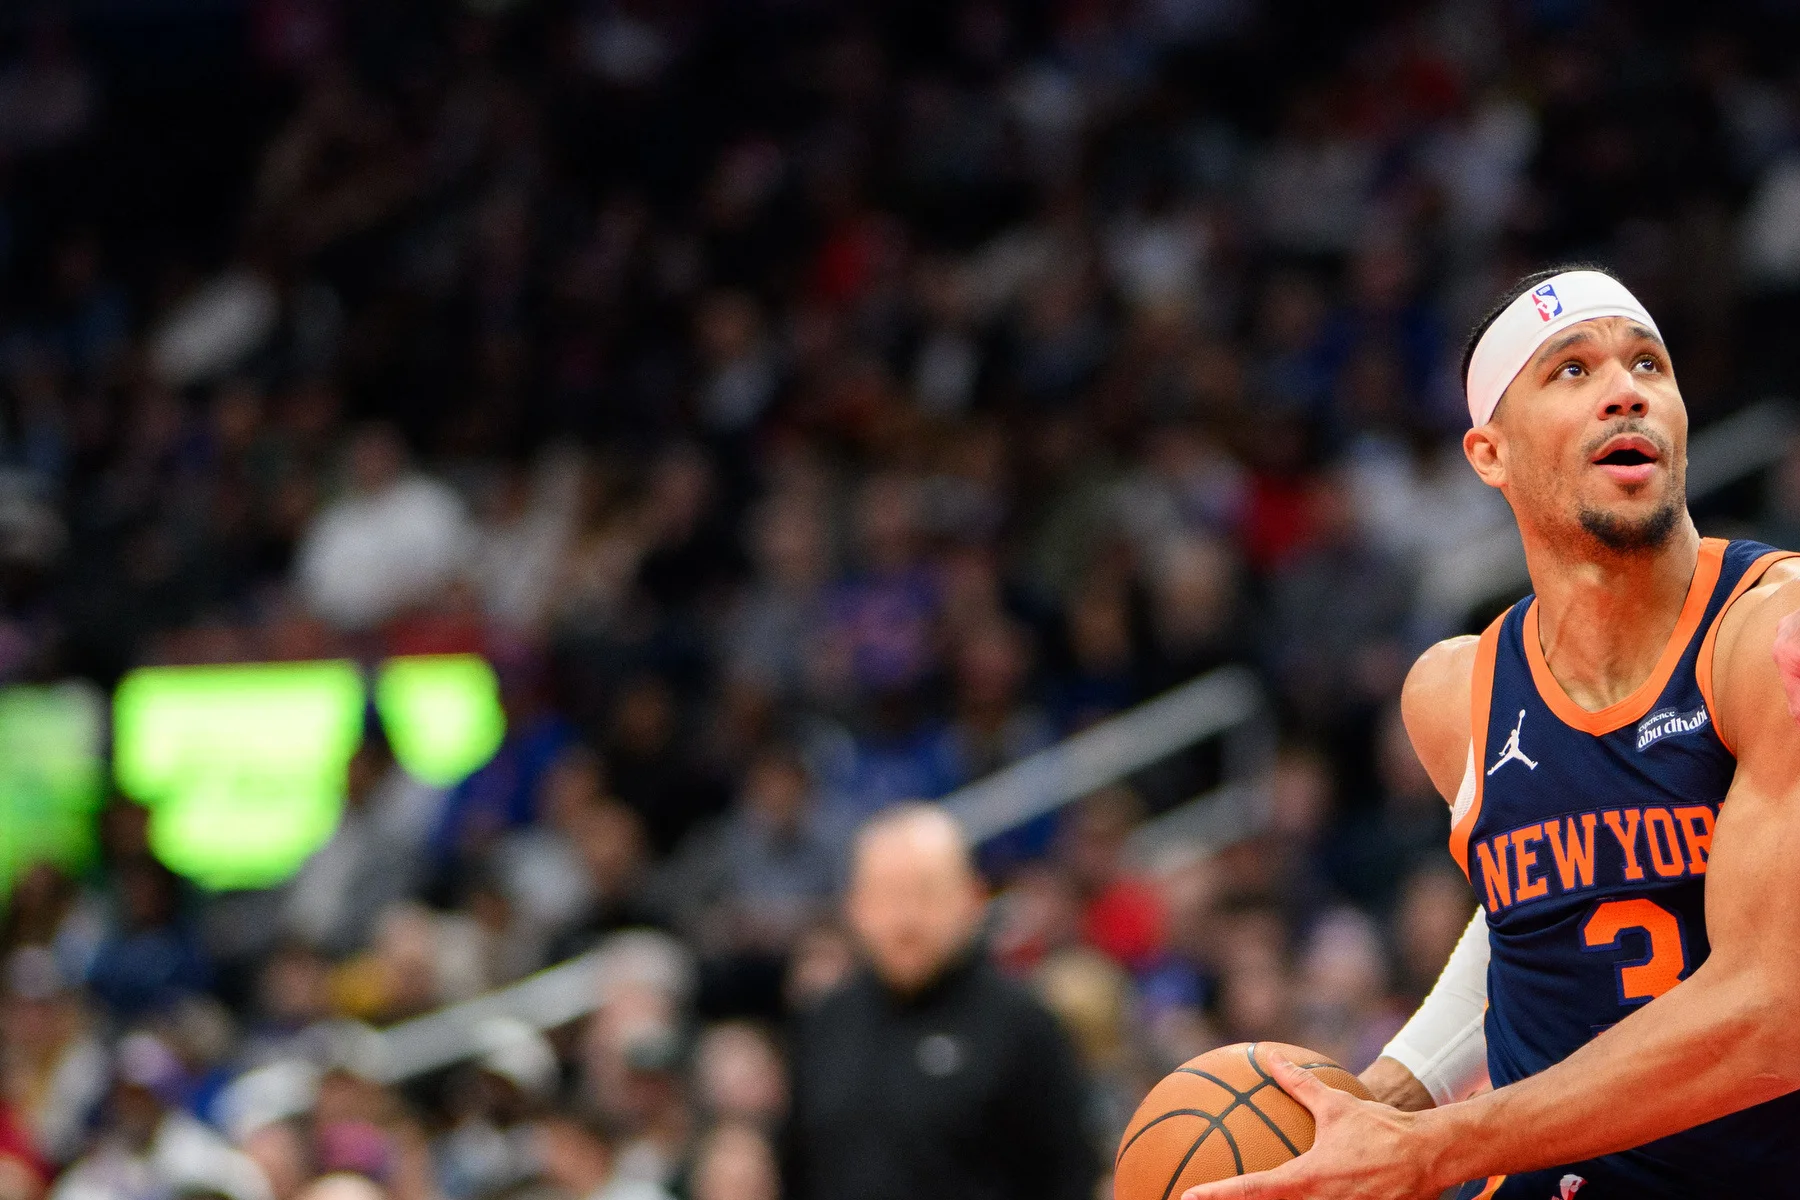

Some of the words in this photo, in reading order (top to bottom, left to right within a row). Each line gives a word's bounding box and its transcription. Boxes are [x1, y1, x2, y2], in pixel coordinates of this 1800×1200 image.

[1638, 725, 1663, 749] abu
[1664, 705, 1708, 734] dhabi
[1475, 812, 1598, 914] NEW
[1602, 802, 1725, 881] YOR
[1582, 898, 1686, 1002] 3
